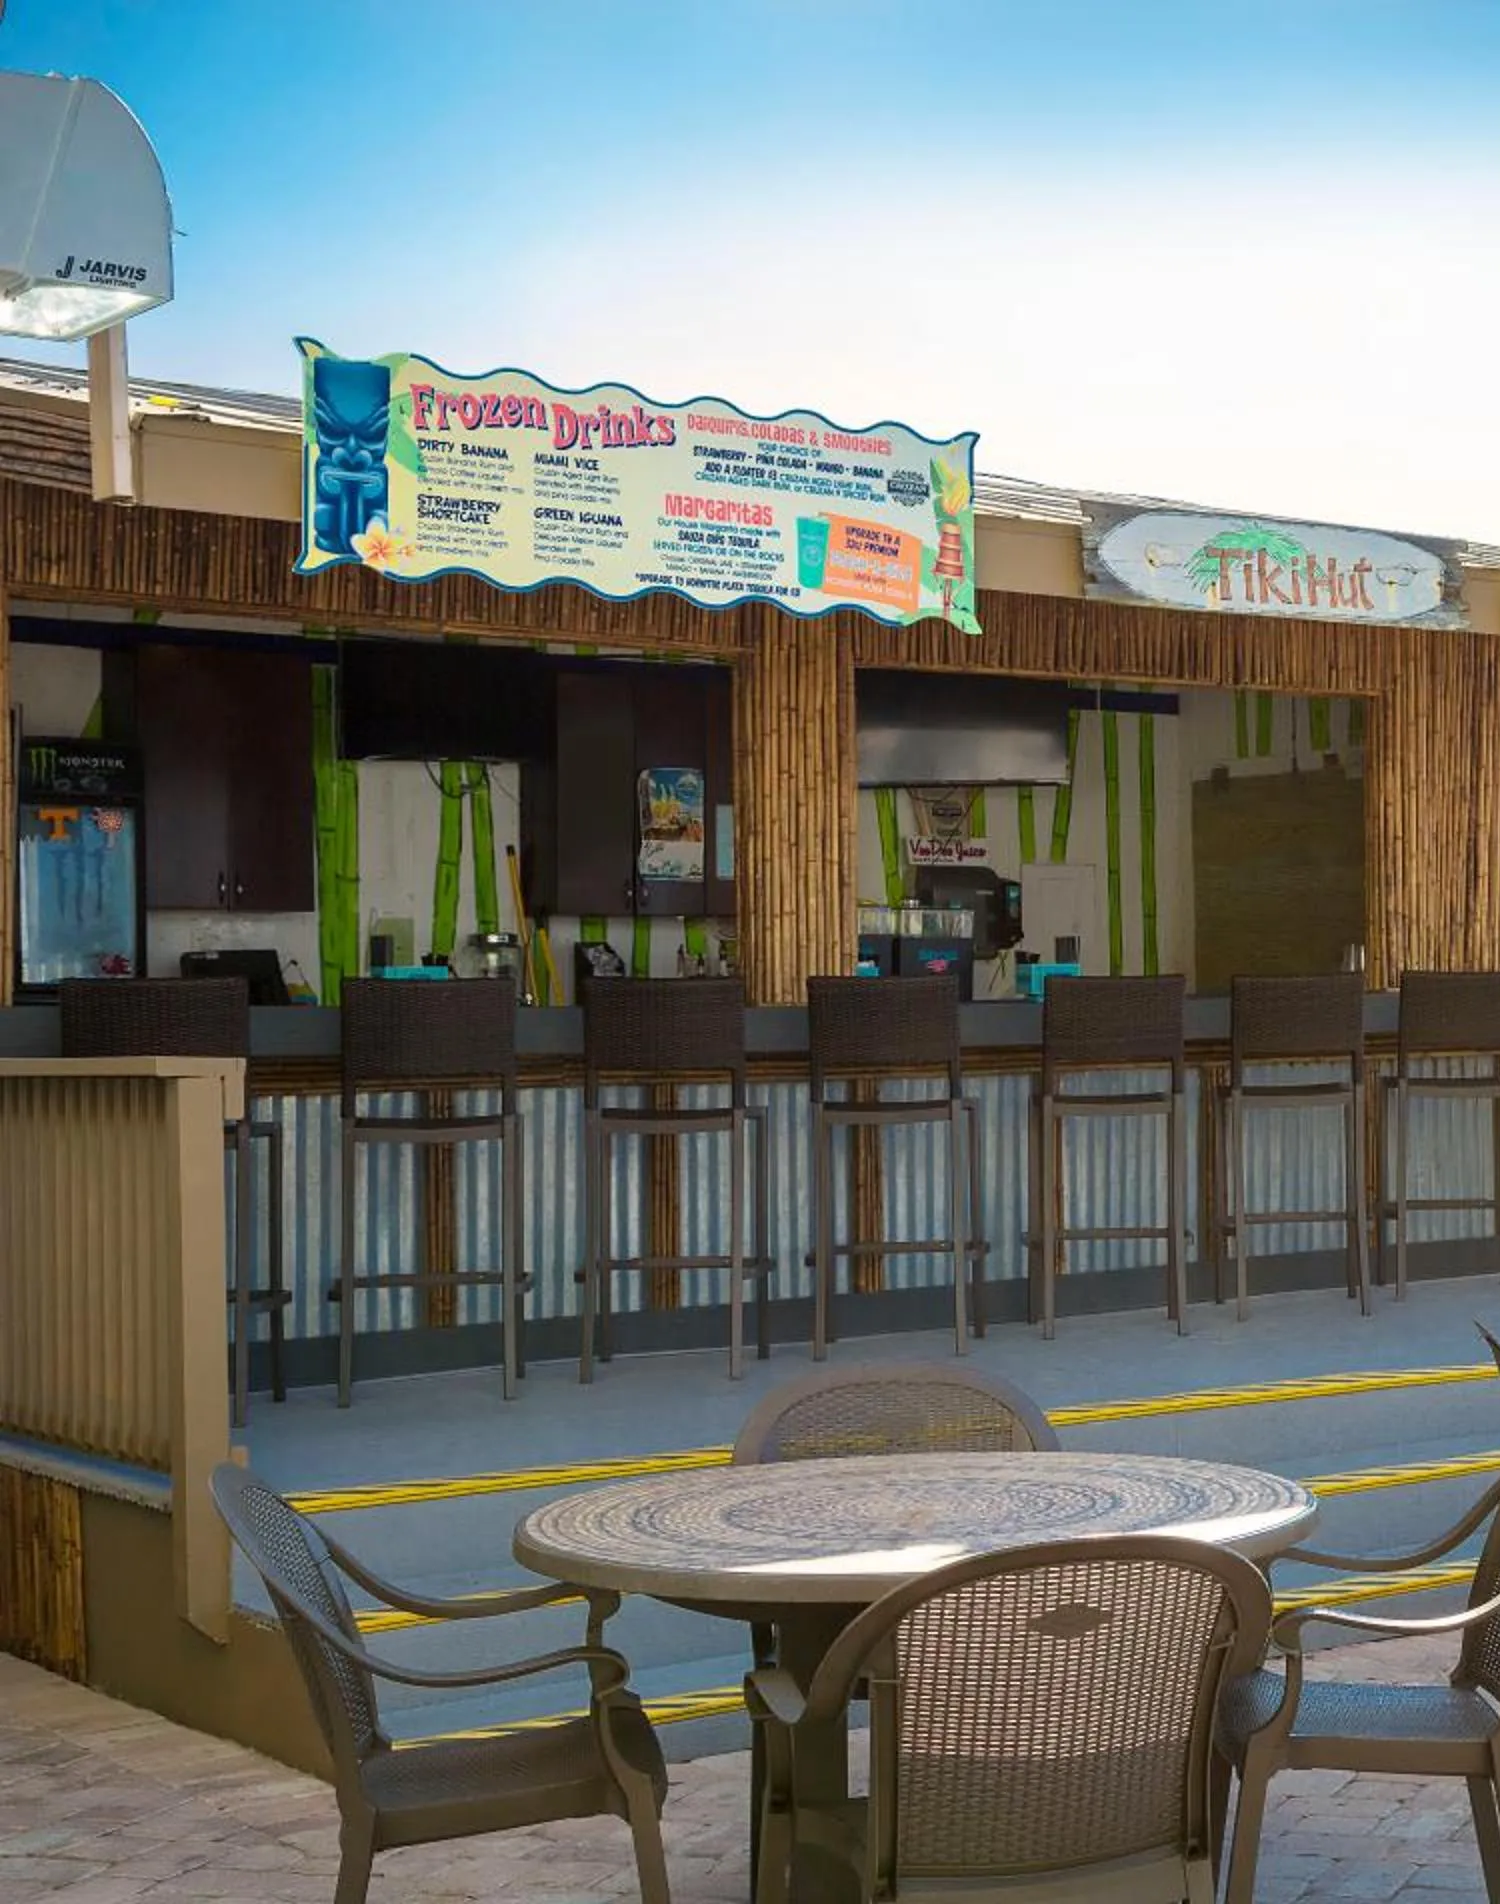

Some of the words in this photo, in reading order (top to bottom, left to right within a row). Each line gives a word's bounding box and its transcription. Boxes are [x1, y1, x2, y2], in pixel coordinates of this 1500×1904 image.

[80, 259, 147, 281] JARVIS
[410, 383, 548, 431] Frozen
[552, 404, 676, 450] Drinks
[809, 429, 819, 447] &
[418, 438, 454, 453] DIRTY
[461, 443, 509, 460] BANANA
[534, 453, 569, 468] MIAMI
[574, 457, 600, 471] VICE
[693, 445, 747, 462] STRAWBERRY
[776, 456, 807, 470] COLADA
[816, 461, 844, 475] MANGO
[852, 465, 884, 479] BANANA
[704, 461, 722, 473] ADD
[724, 463, 731, 474] A
[732, 464, 767, 479] FLOATER
[417, 493, 501, 513] STRAWBERRY
[417, 507, 491, 525] SHORTCAKE
[534, 507, 574, 521] GREEN
[579, 511, 623, 527] IGUANA
[657, 517, 672, 527] Our
[727, 535, 760, 549] TEQUILA
[845, 525, 881, 540] UPGRADE
[883, 533, 893, 544] TO
[653, 539, 683, 551] SERVED
[684, 543, 713, 554] FROZEN
[715, 547, 727, 557] OR
[729, 548, 742, 558] ON
[743, 549, 757, 559] THE
[758, 551, 785, 563] ROCKS
[58, 756, 125, 770] MONSTER
